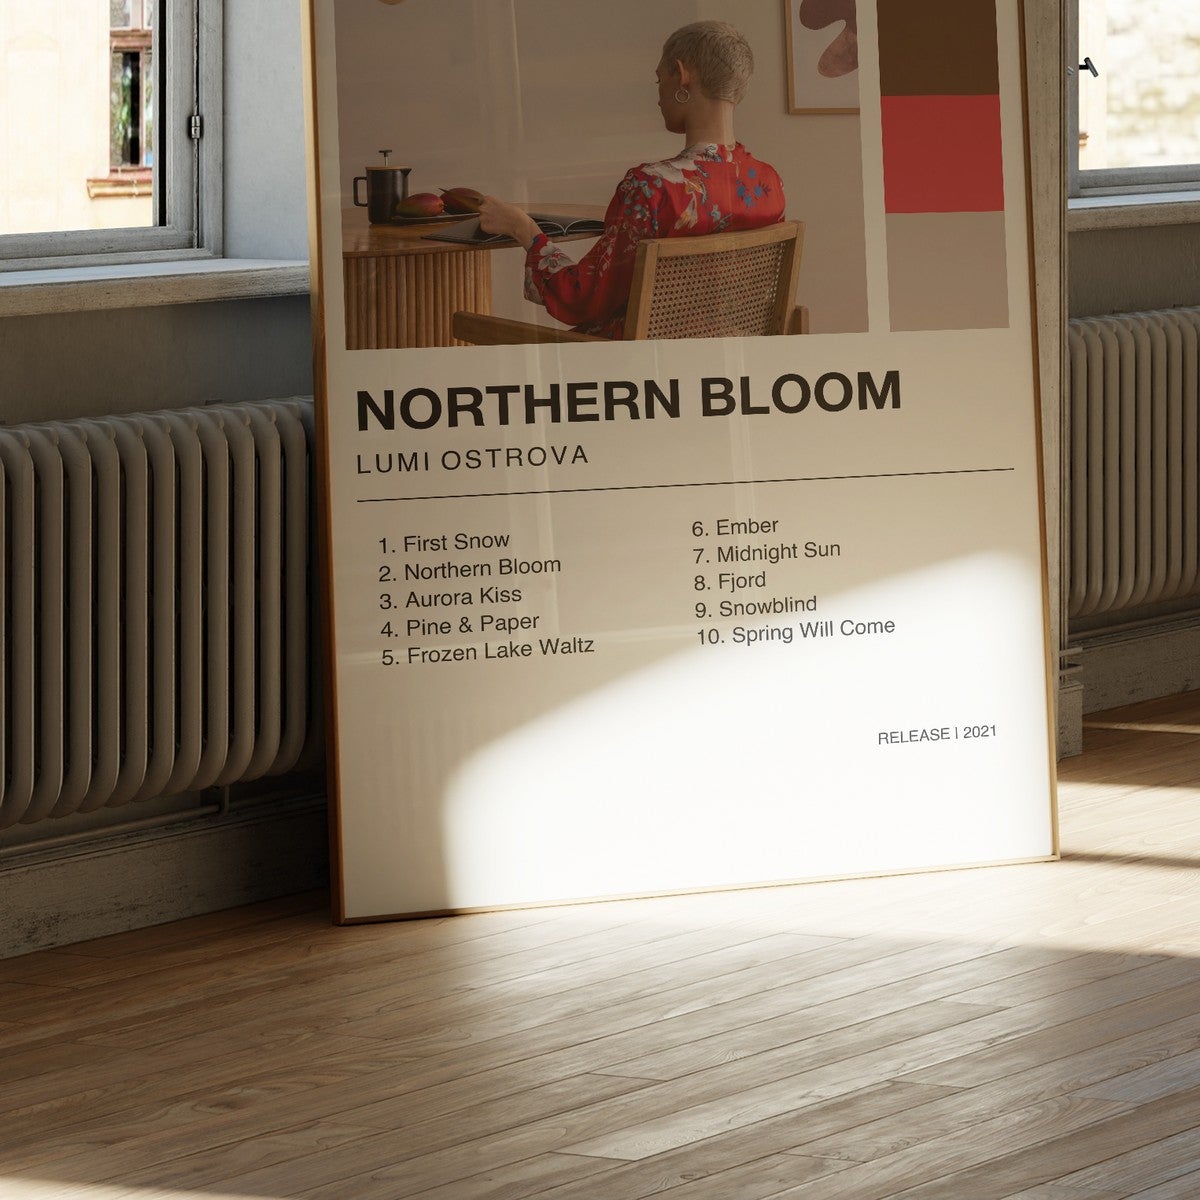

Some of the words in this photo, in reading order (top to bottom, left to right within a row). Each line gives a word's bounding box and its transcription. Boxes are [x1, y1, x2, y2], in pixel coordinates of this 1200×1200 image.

[356, 378, 681, 432] NORTHERN
[700, 369, 901, 418] BLOOM
[356, 451, 429, 475] LUMI
[440, 444, 589, 471] OSTROVA
[691, 520, 709, 538] 6.
[716, 517, 779, 536] Ember
[378, 537, 396, 554] 1.
[403, 534, 448, 553] First
[453, 532, 511, 551] Snow
[692, 547, 710, 565] 7.
[717, 543, 799, 565] Midnight
[803, 541, 841, 559] Sun
[378, 565, 397, 583] 2.
[404, 561, 492, 581] Northern
[498, 557, 562, 576] Bloom
[694, 574, 711, 592] 8.
[718, 570, 767, 594] Fjord
[379, 593, 398, 611] 3.
[405, 590, 474, 609] Aurora
[479, 586, 523, 605] Kiss
[694, 601, 712, 619] 9.
[719, 594, 817, 618] Snowblind
[380, 620, 399, 638] 4.
[406, 618, 452, 637] Pine
[458, 616, 474, 634] &
[480, 614, 540, 635] Paper
[697, 627, 725, 646] 10.
[732, 624, 793, 647] Spring
[799, 620, 834, 639] Will
[839, 619, 896, 637] Come
[381, 649, 400, 666] 5.
[407, 646, 477, 664] Frozen
[484, 640, 533, 660] Lake
[538, 636, 595, 656] Waltz
[878, 727, 951, 746] RELEASE
[963, 724, 996, 739] 2021
